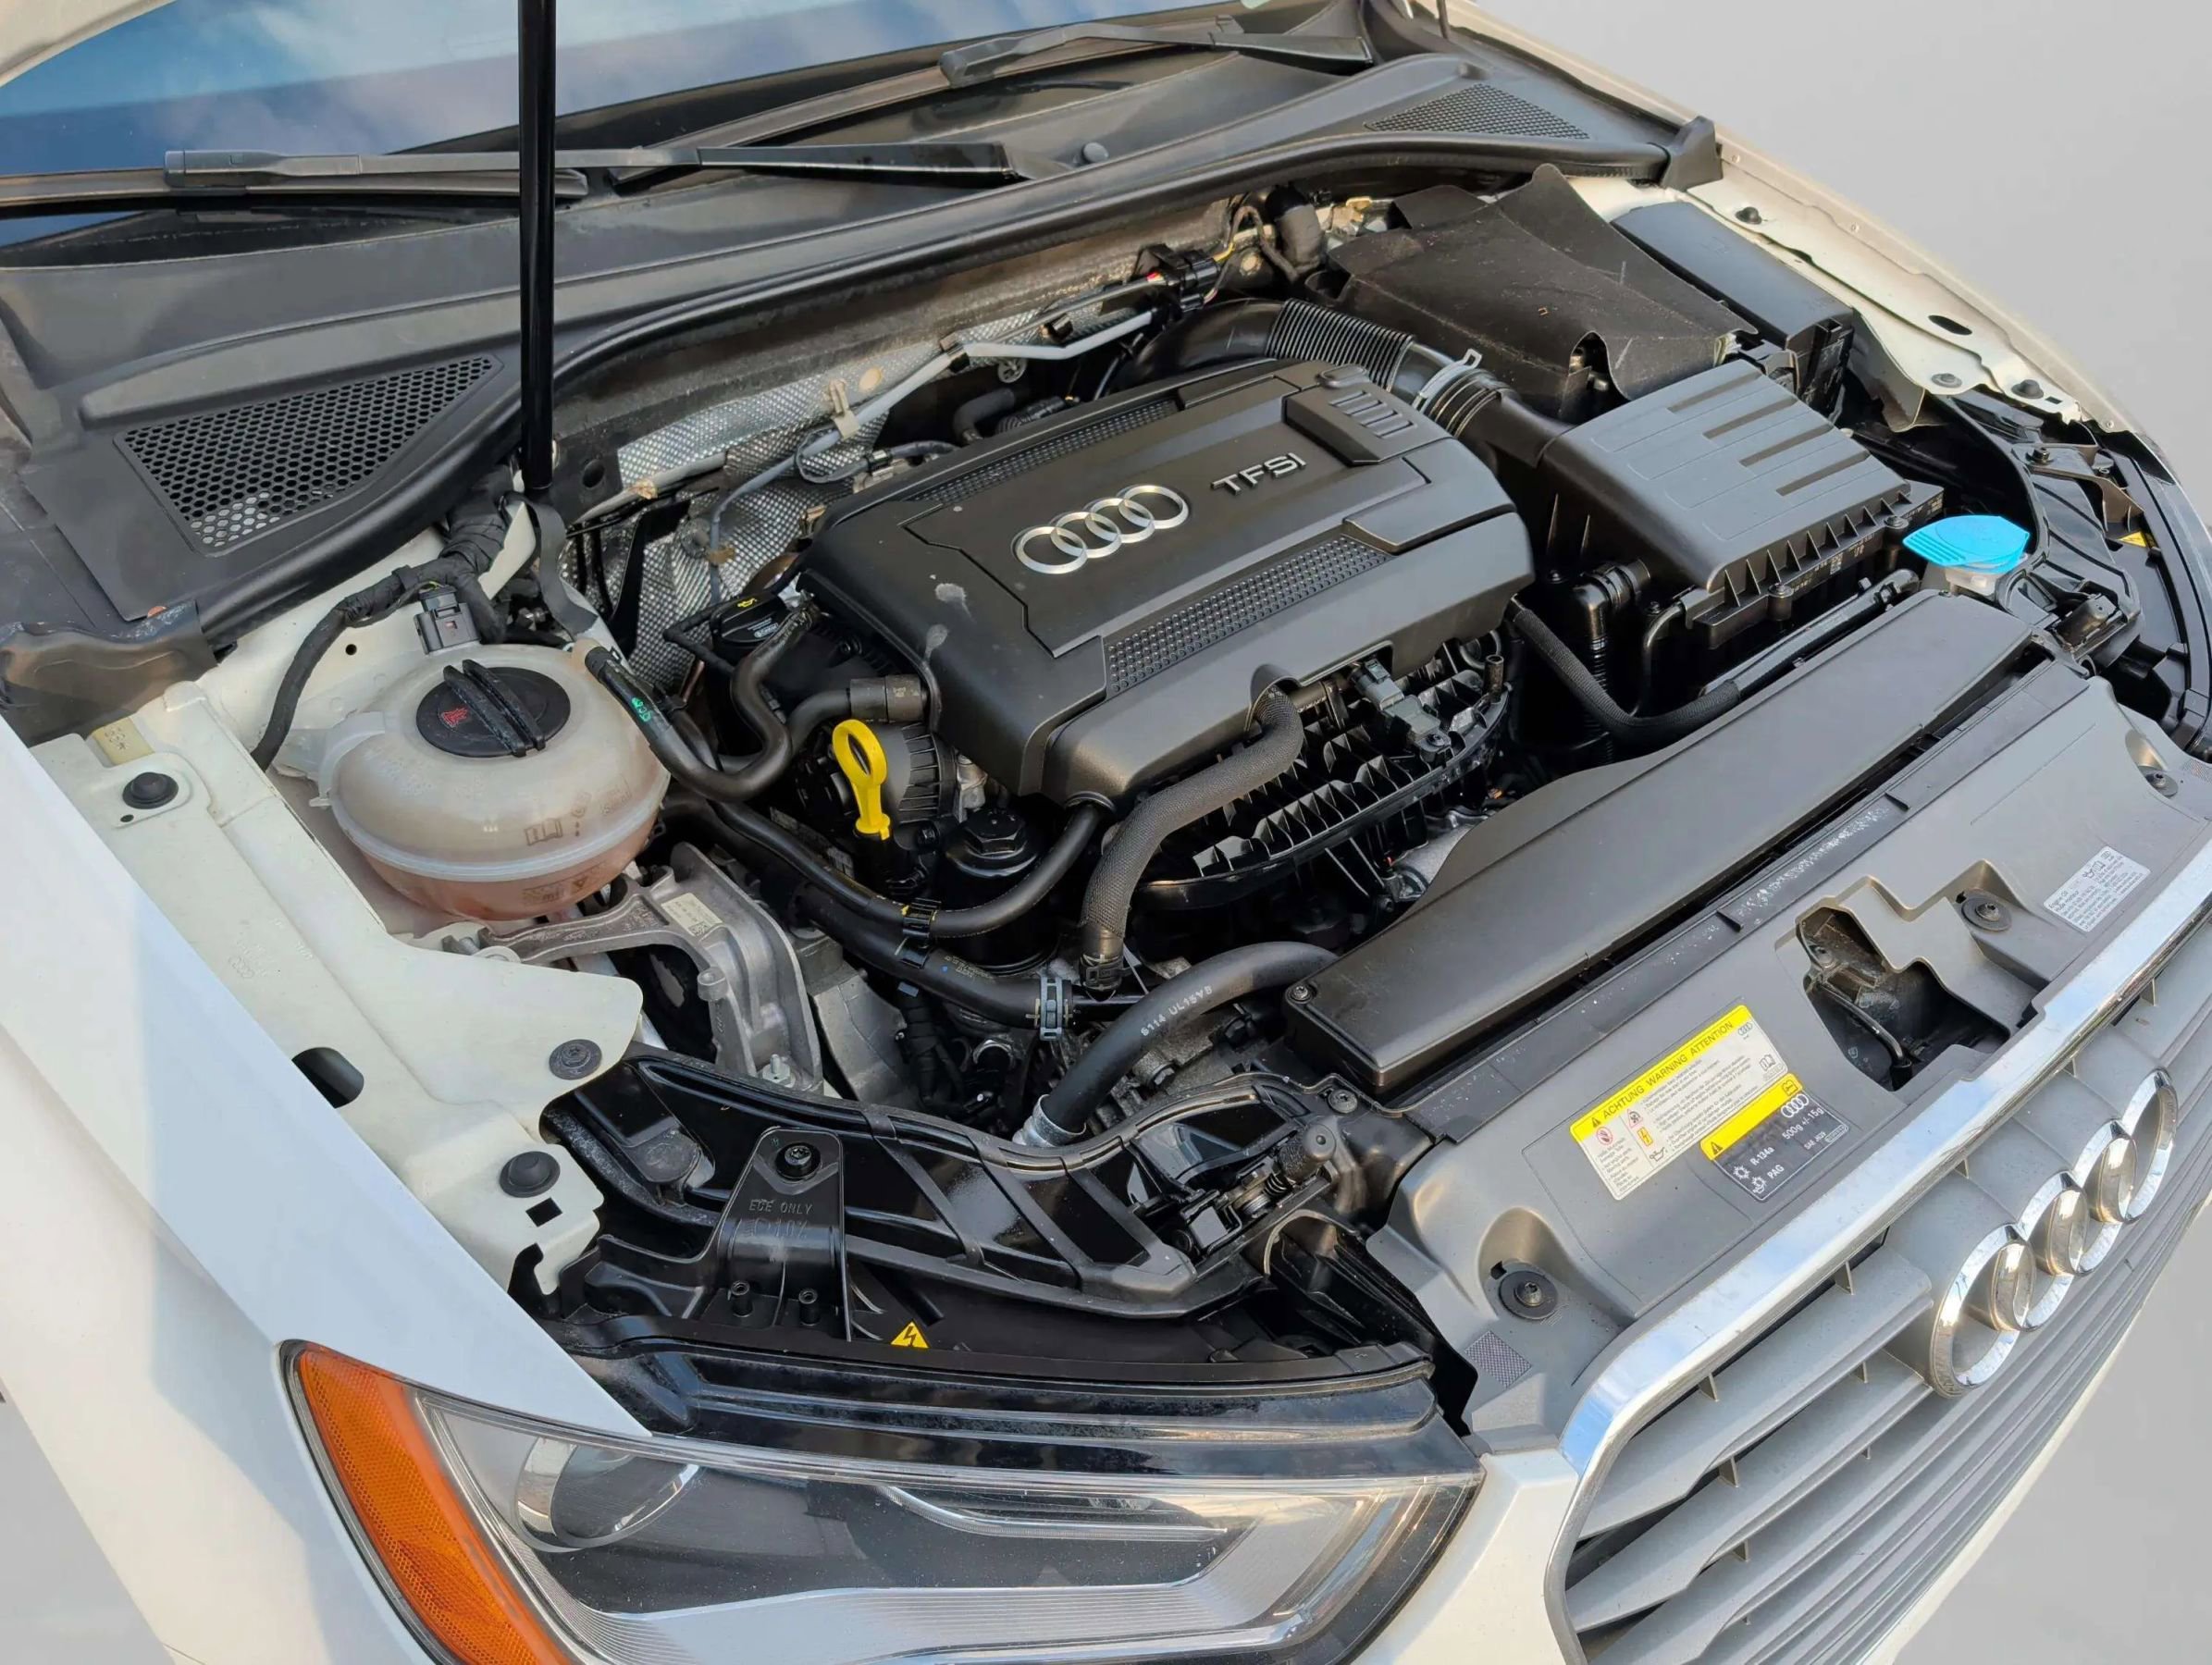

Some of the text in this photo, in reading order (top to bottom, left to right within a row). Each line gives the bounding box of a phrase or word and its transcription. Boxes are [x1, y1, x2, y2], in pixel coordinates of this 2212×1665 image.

[1210, 452, 1307, 495] TFSI
[1603, 1085, 1645, 1119] ACHTUNG
[1646, 1054, 1688, 1087] WARNING
[1689, 1020, 1734, 1056] ATTENTION
[1749, 1146, 1775, 1166] R-134a
[1782, 1124, 1804, 1140] 500g
[1767, 1164, 1785, 1179] PAG
[780, 1202, 812, 1215] ONLY
